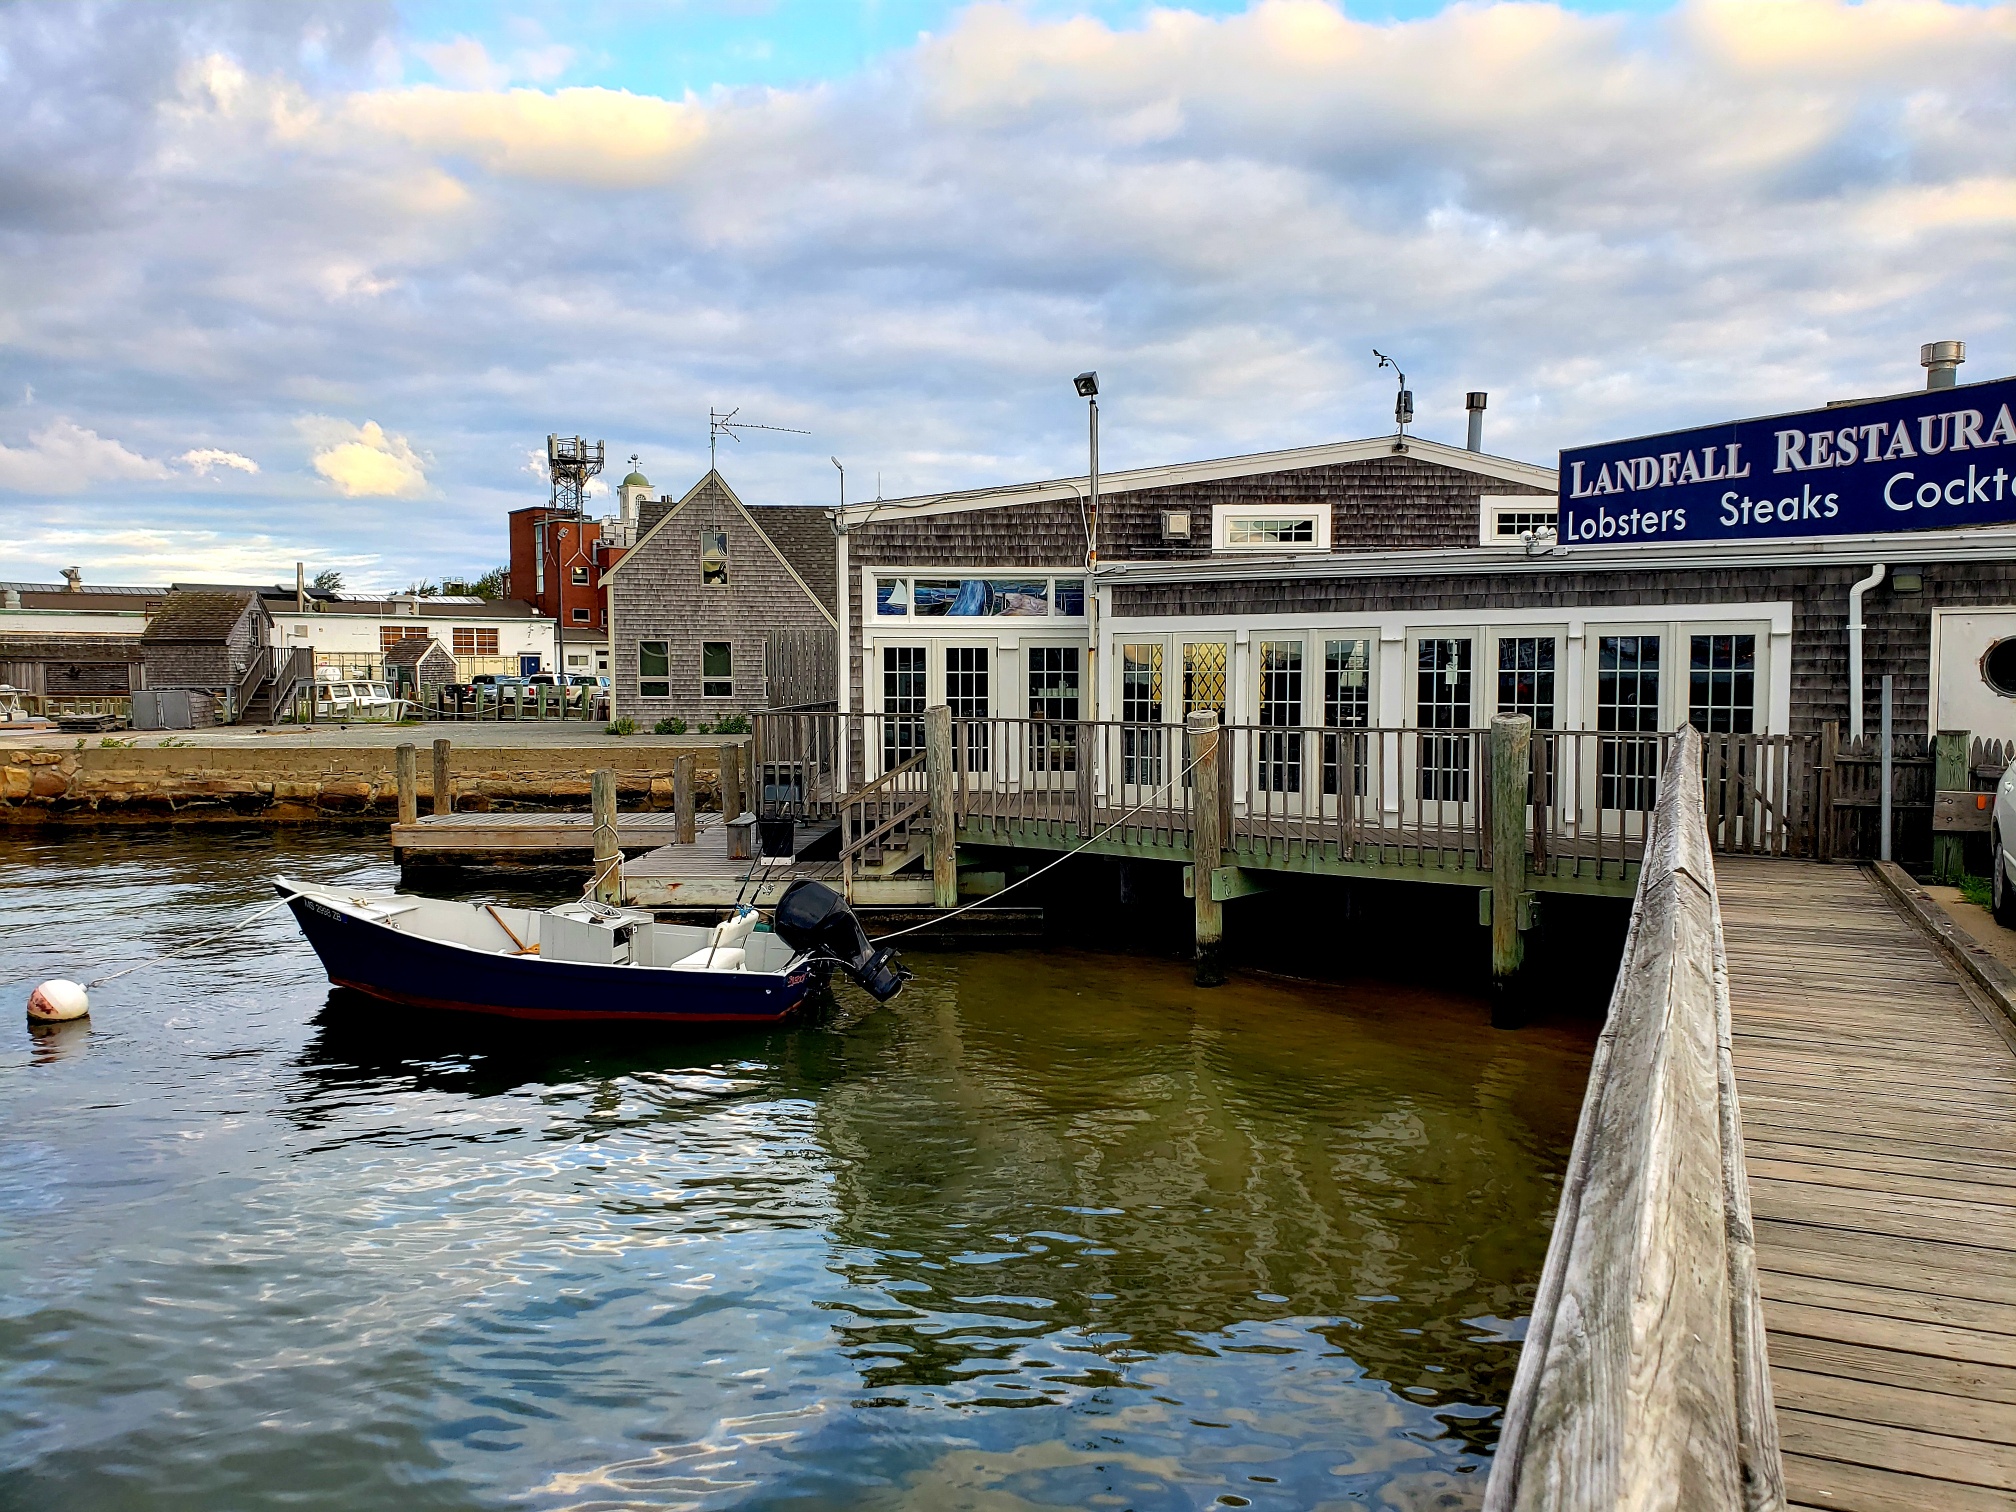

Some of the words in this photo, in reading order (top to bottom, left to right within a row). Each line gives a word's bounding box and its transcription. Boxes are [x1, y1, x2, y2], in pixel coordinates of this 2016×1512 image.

[1570, 443, 1750, 499] LANDFALL
[1567, 507, 1686, 540] Lobsters
[1719, 484, 1839, 526] Steaks
[1884, 464, 2016, 511] Cockt
[304, 899, 315, 911] MS
